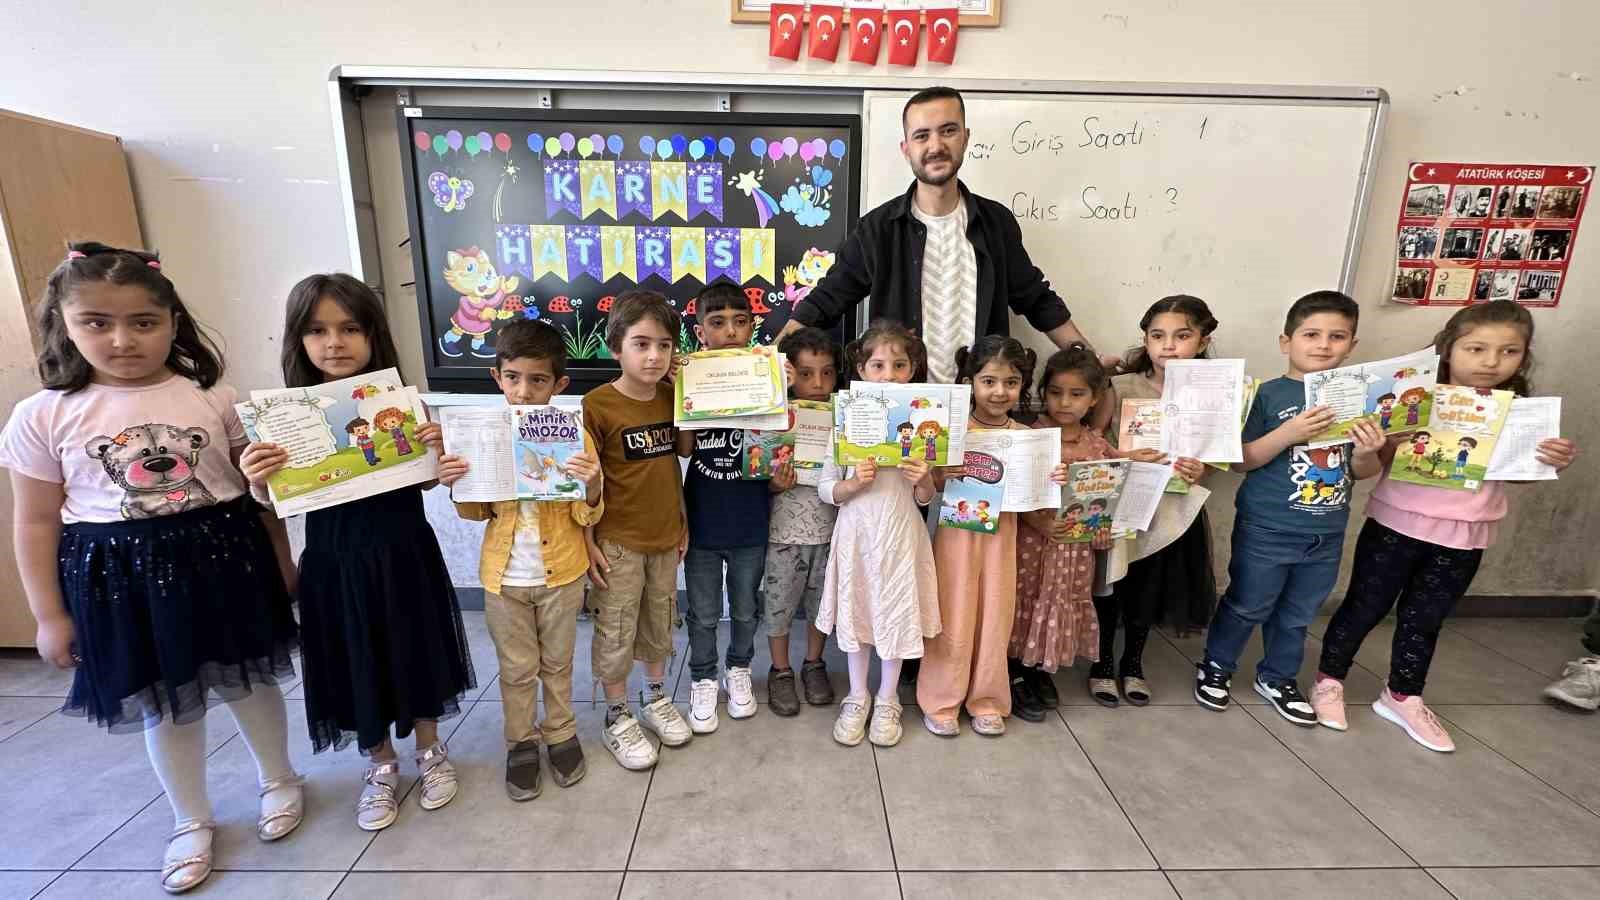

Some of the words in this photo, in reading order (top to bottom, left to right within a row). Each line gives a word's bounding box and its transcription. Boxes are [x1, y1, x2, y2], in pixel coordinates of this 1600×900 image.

[553, 174, 714, 203] KARNE
[1456, 167, 1504, 179] ATATÜRK
[1506, 167, 1545, 181] KÖŞESİ
[502, 237, 763, 268] HATIRASI
